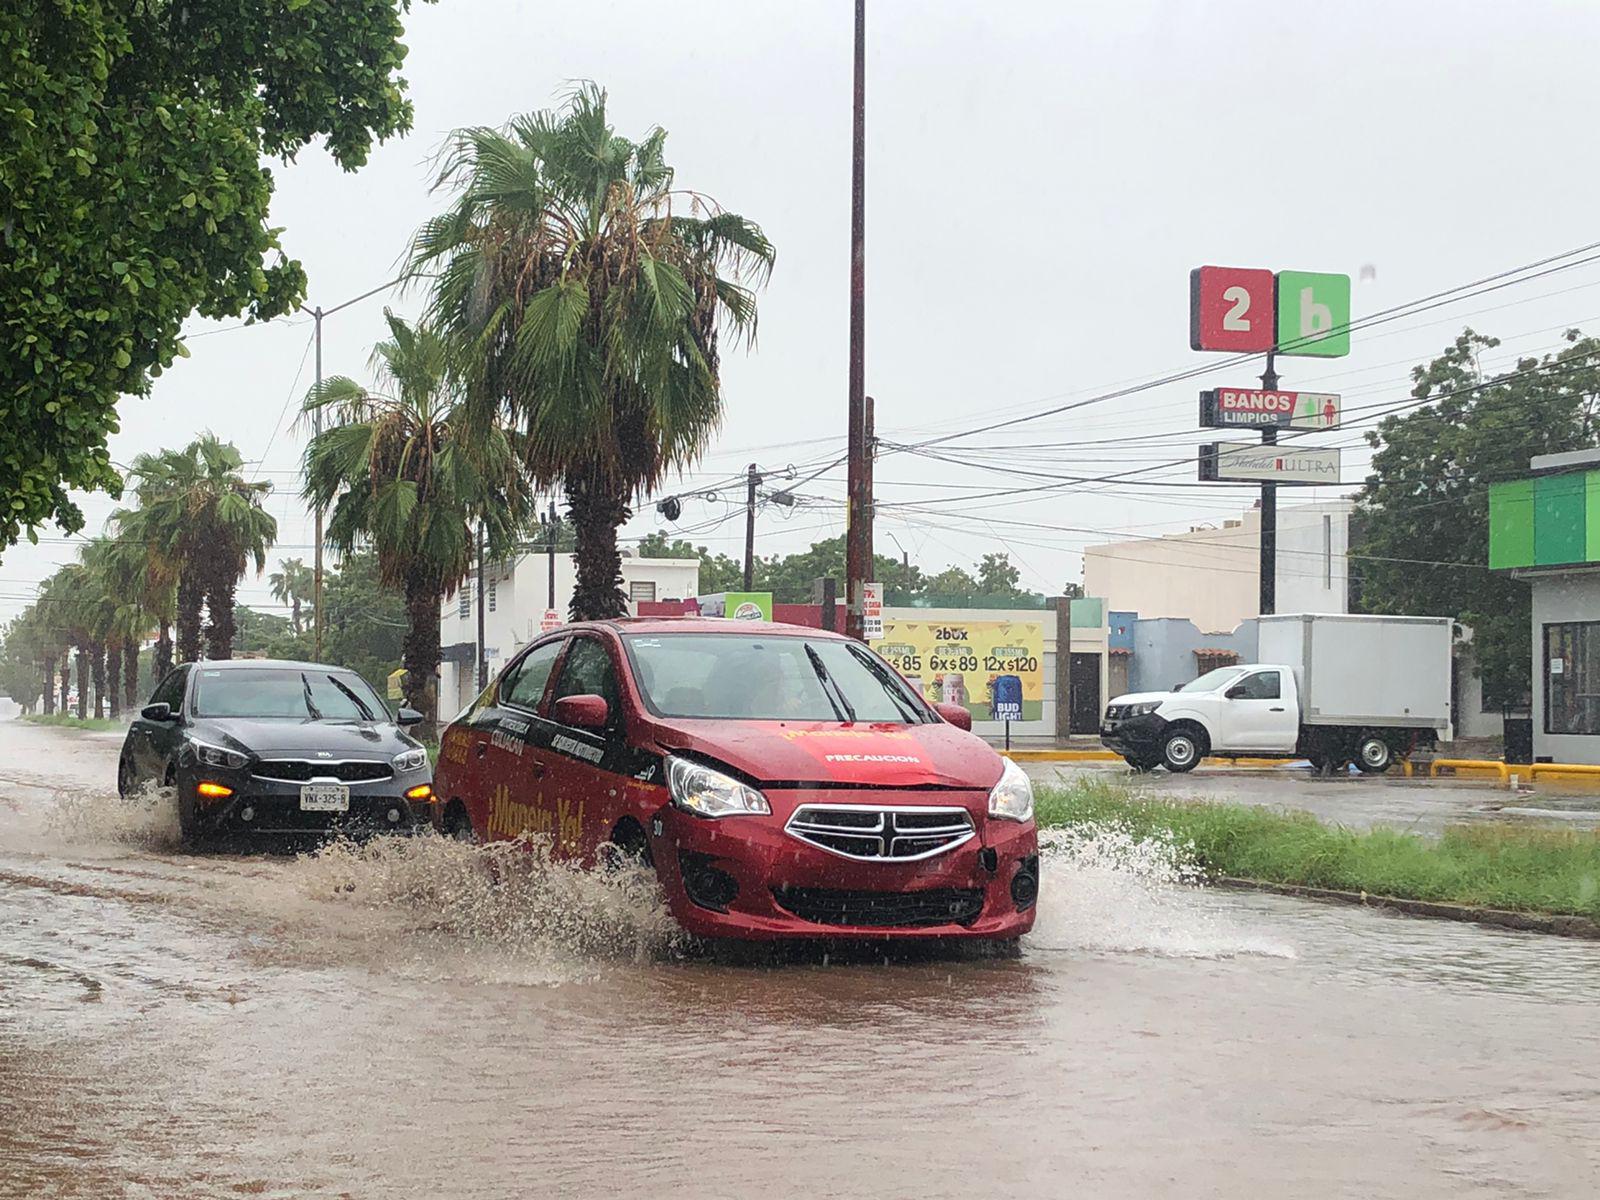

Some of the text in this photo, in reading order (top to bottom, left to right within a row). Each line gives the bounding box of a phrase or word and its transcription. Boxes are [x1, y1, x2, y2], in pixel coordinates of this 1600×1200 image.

[1223, 286, 1332, 341] 2 b
[1223, 391, 1291, 411] BAÑOS
[1224, 412, 1279, 424] LIMPIOS
[1284, 458, 1336, 474] ULTRA
[997, 702, 1019, 712] BUD
[995, 712, 1021, 721] LIGHT
[824, 754, 920, 764] PRECAUCION
